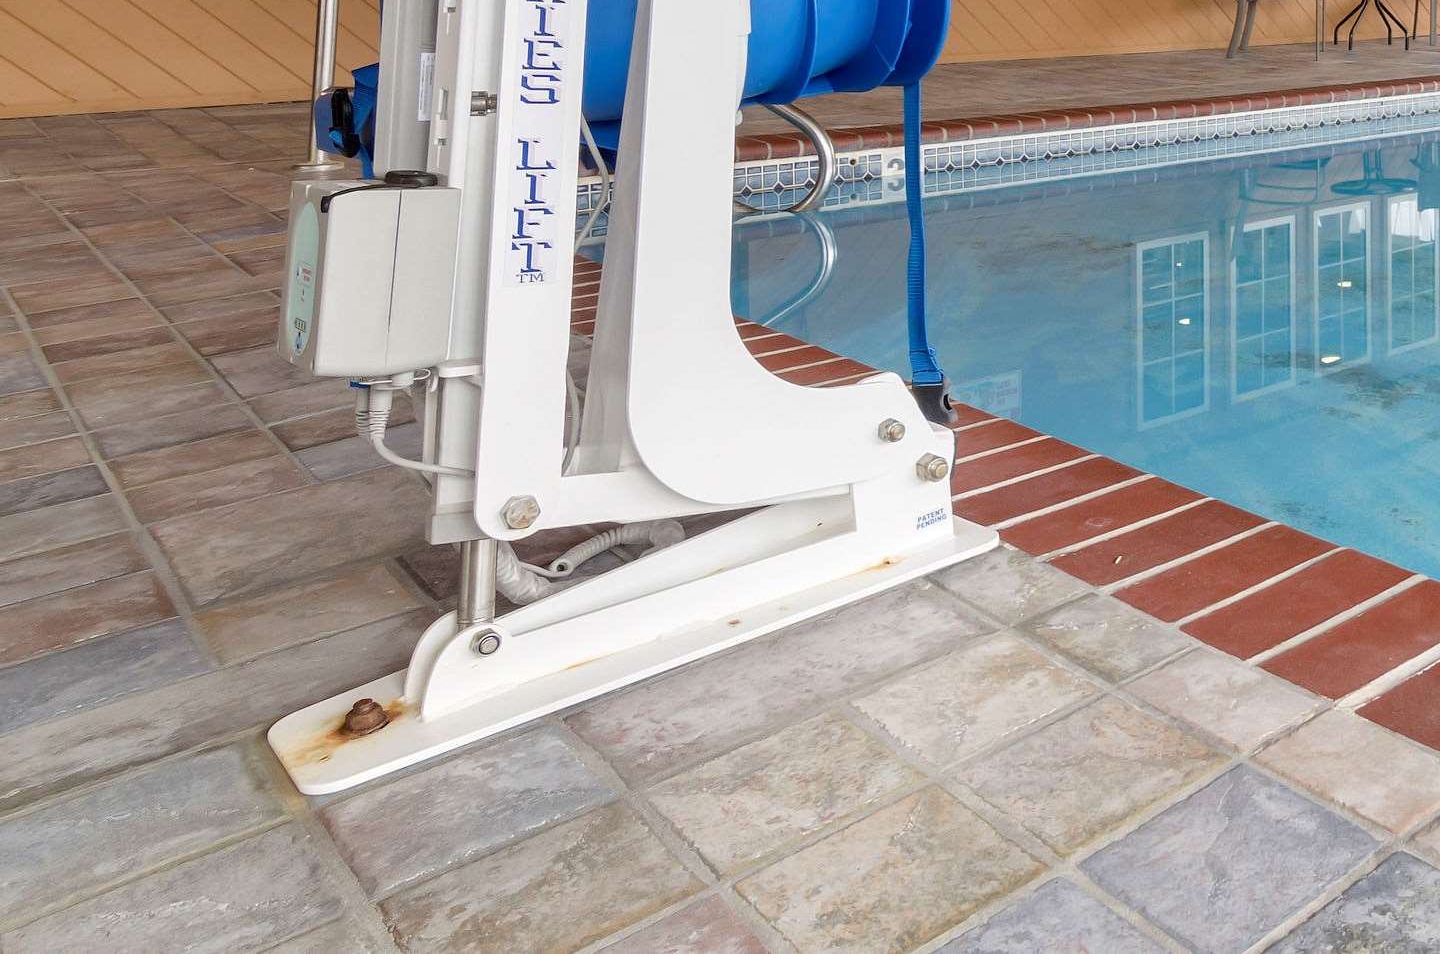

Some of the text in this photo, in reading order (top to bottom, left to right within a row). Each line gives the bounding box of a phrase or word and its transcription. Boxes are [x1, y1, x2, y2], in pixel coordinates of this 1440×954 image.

[511, 138, 557, 274] LIFT
[916, 514, 948, 531] PENDING
[917, 507, 944, 523] PATENT
